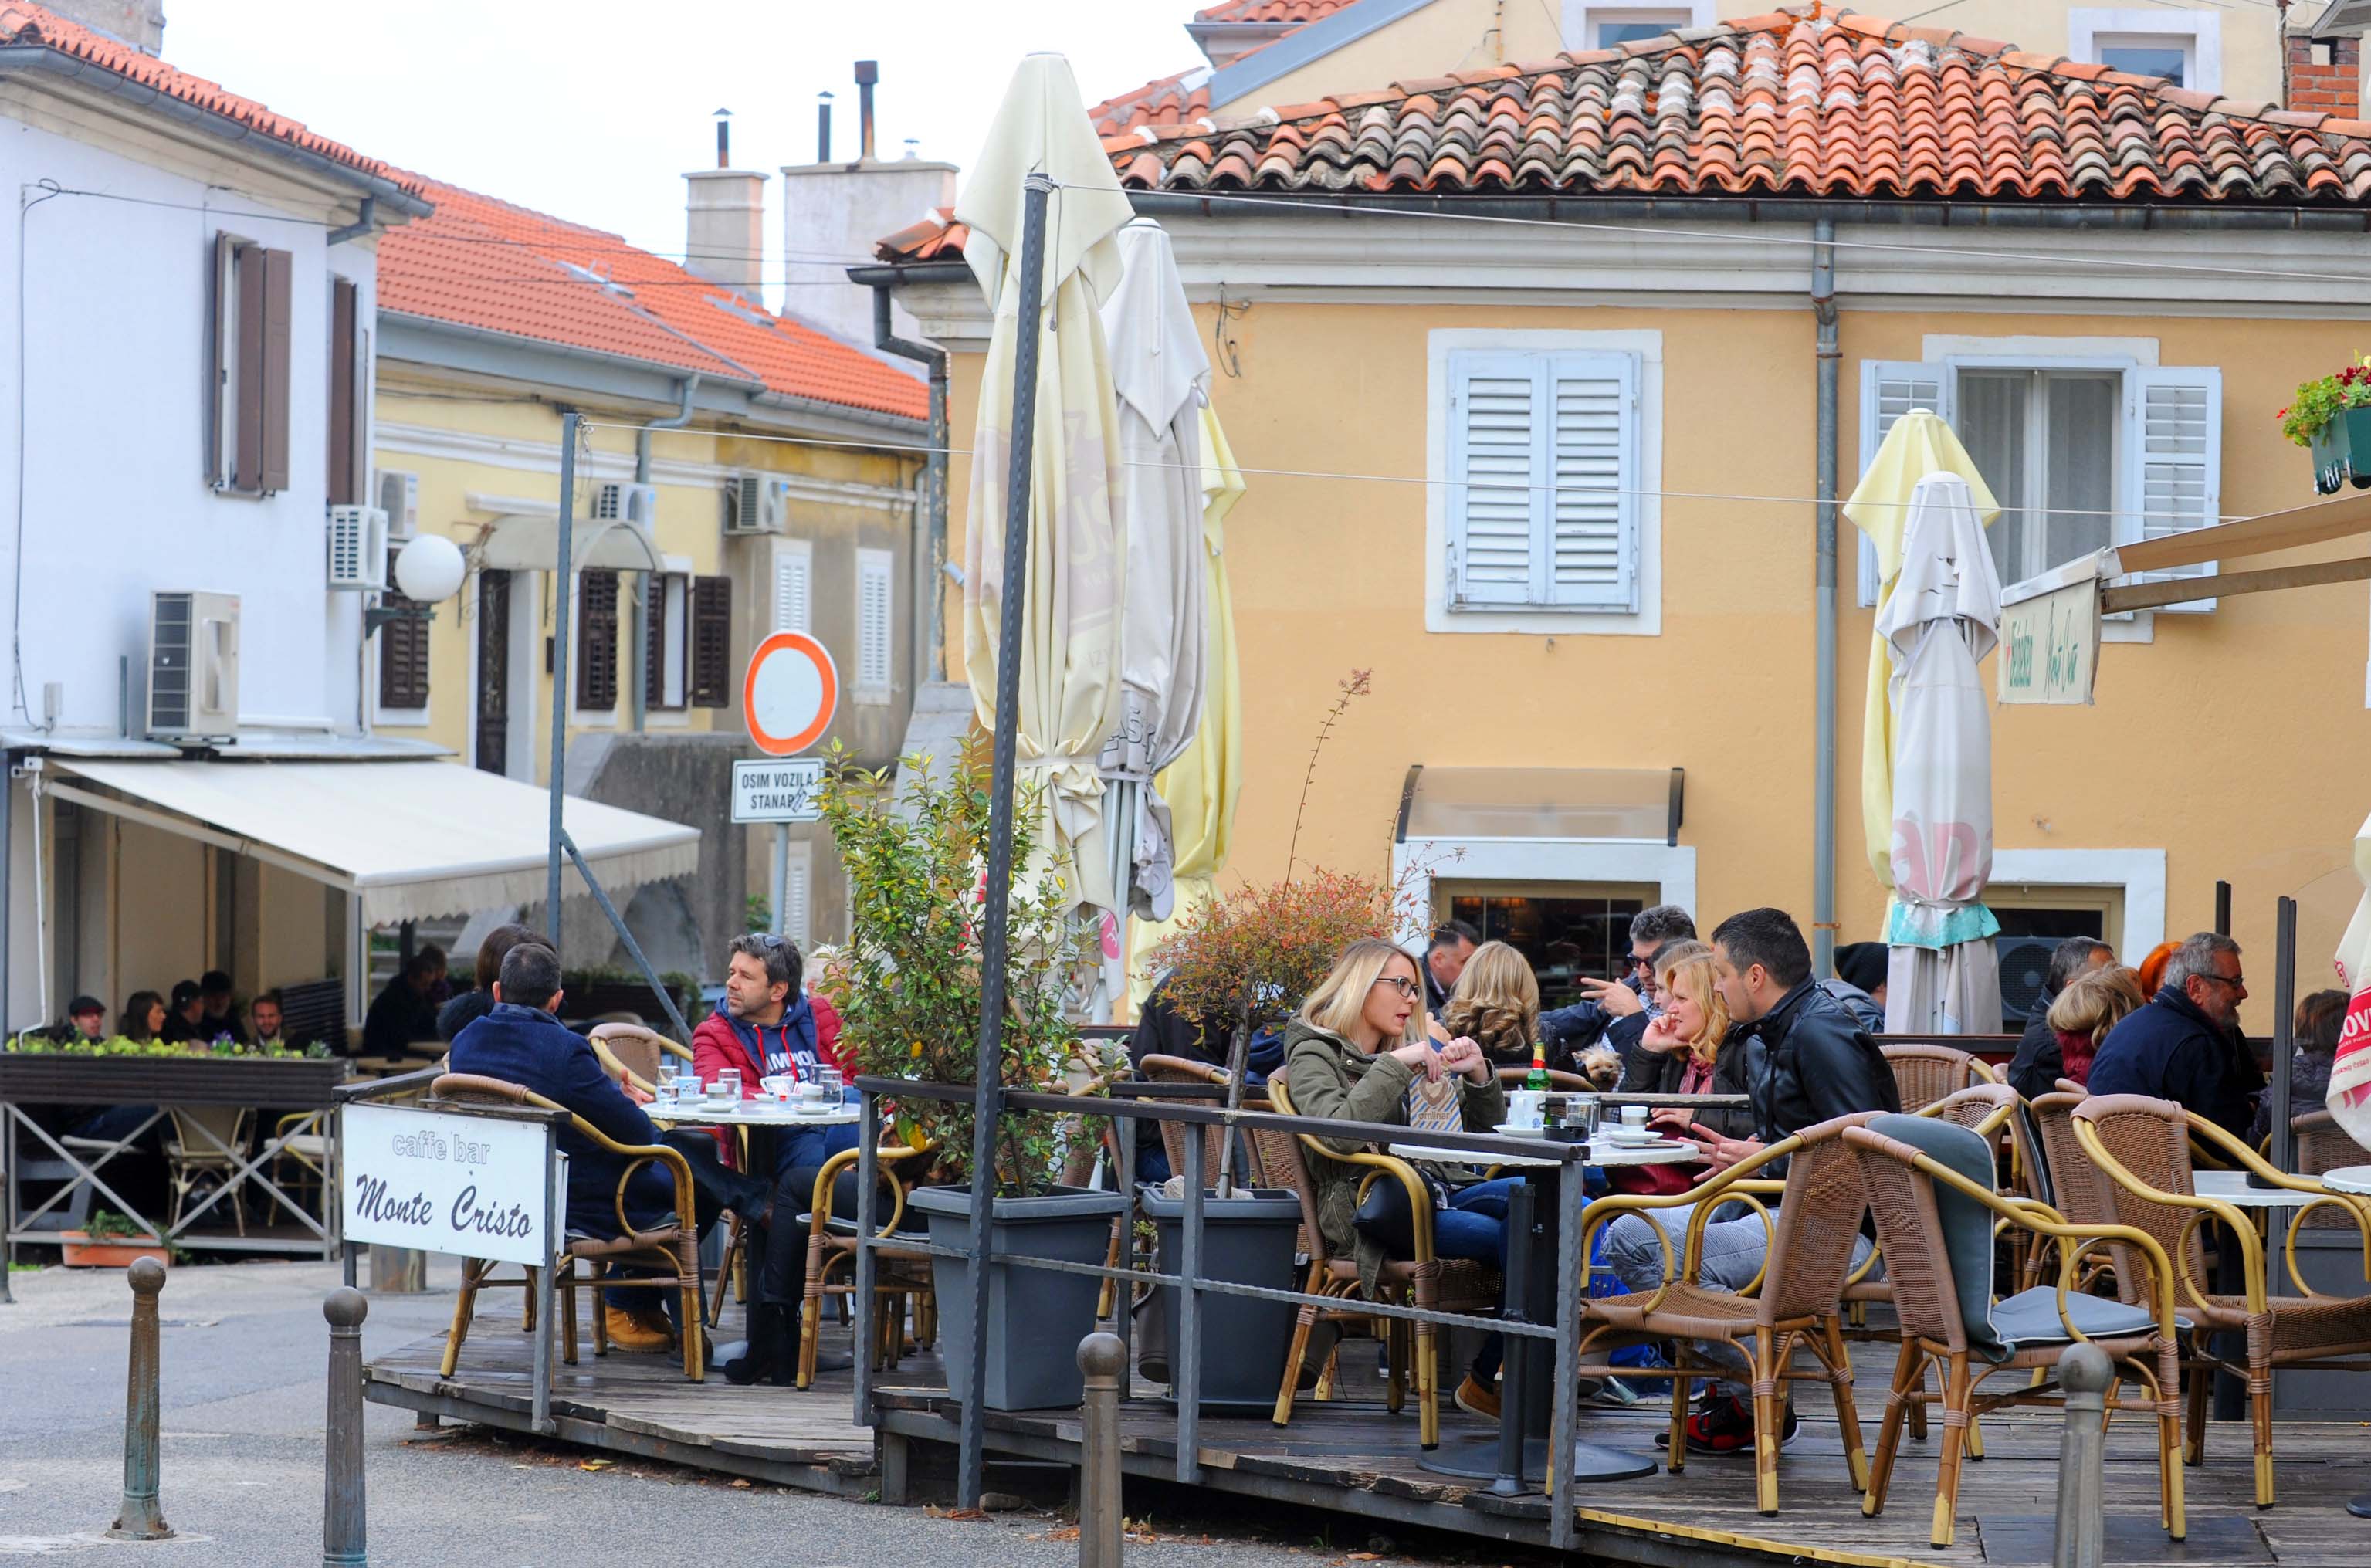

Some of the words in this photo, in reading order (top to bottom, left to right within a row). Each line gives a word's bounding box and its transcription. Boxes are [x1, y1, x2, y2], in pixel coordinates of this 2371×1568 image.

[742, 774, 770, 788] OSIM
[774, 773, 813, 787] VOZILA
[392, 1130, 447, 1160] caffe
[453, 1133, 491, 1164] bar
[356, 1173, 432, 1226] Monte
[451, 1185, 533, 1238] Cristo
